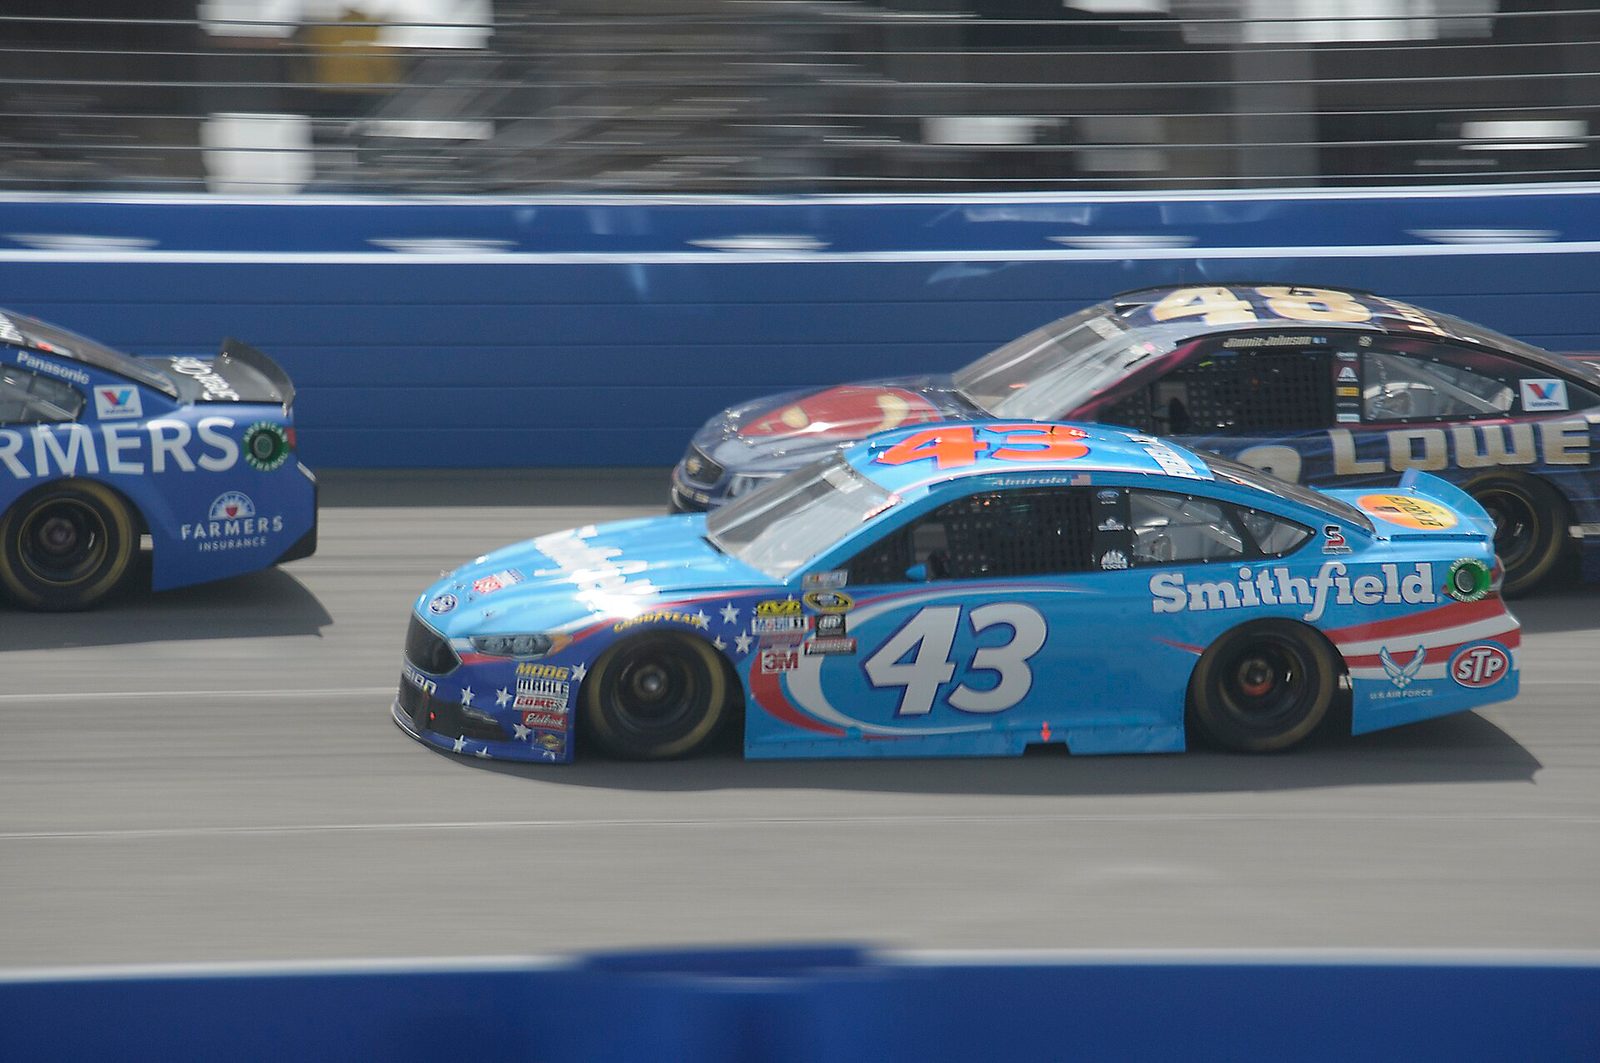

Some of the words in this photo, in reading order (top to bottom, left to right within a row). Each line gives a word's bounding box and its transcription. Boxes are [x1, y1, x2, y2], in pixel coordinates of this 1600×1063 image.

[1150, 287, 1373, 325] 48
[16, 350, 90, 385] Panasonic
[871, 425, 1091, 470] 43
[181, 515, 283, 541] FARMERS
[198, 536, 267, 552] INSURANCE
[1148, 561, 1437, 623] Smithfield
[516, 662, 570, 680] MOOG
[764, 652, 798, 670] 3M
[863, 602, 1048, 716] 43
[1456, 649, 1504, 683] STP
[1386, 690, 1402, 699] AIR
[1402, 689, 1434, 698] FORCE
